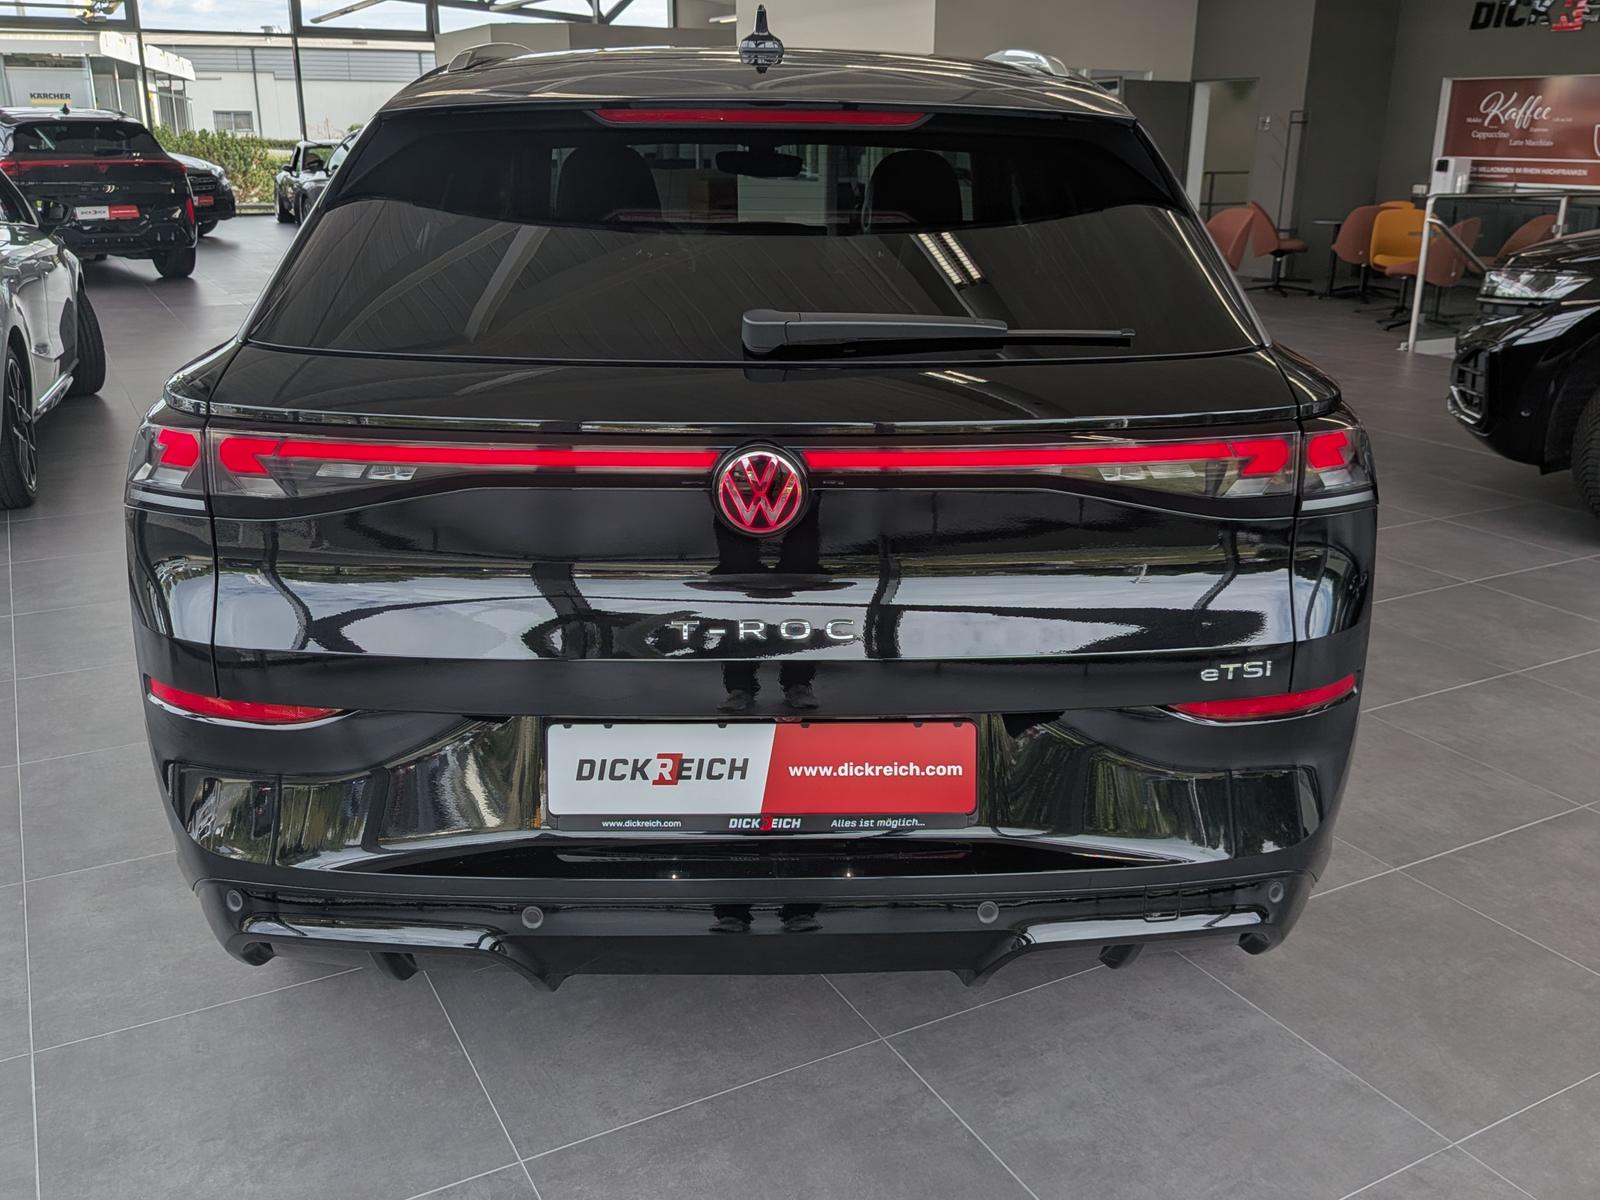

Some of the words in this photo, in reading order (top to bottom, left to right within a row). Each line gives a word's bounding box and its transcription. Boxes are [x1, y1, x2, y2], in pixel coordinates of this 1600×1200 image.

[1480, 91, 1551, 129] Kaffee
[1471, 130, 1510, 139] Cappuccino
[720, 454, 801, 530] VW
[671, 619, 854, 640] T-ROC
[1200, 660, 1272, 681] eTSi
[576, 753, 749, 785] DICKREICH
[788, 762, 963, 777] www.dickreich.com
[602, 819, 682, 828] www.dickreich.com
[830, 819, 857, 828] Alles
[858, 818, 874, 828] ist
